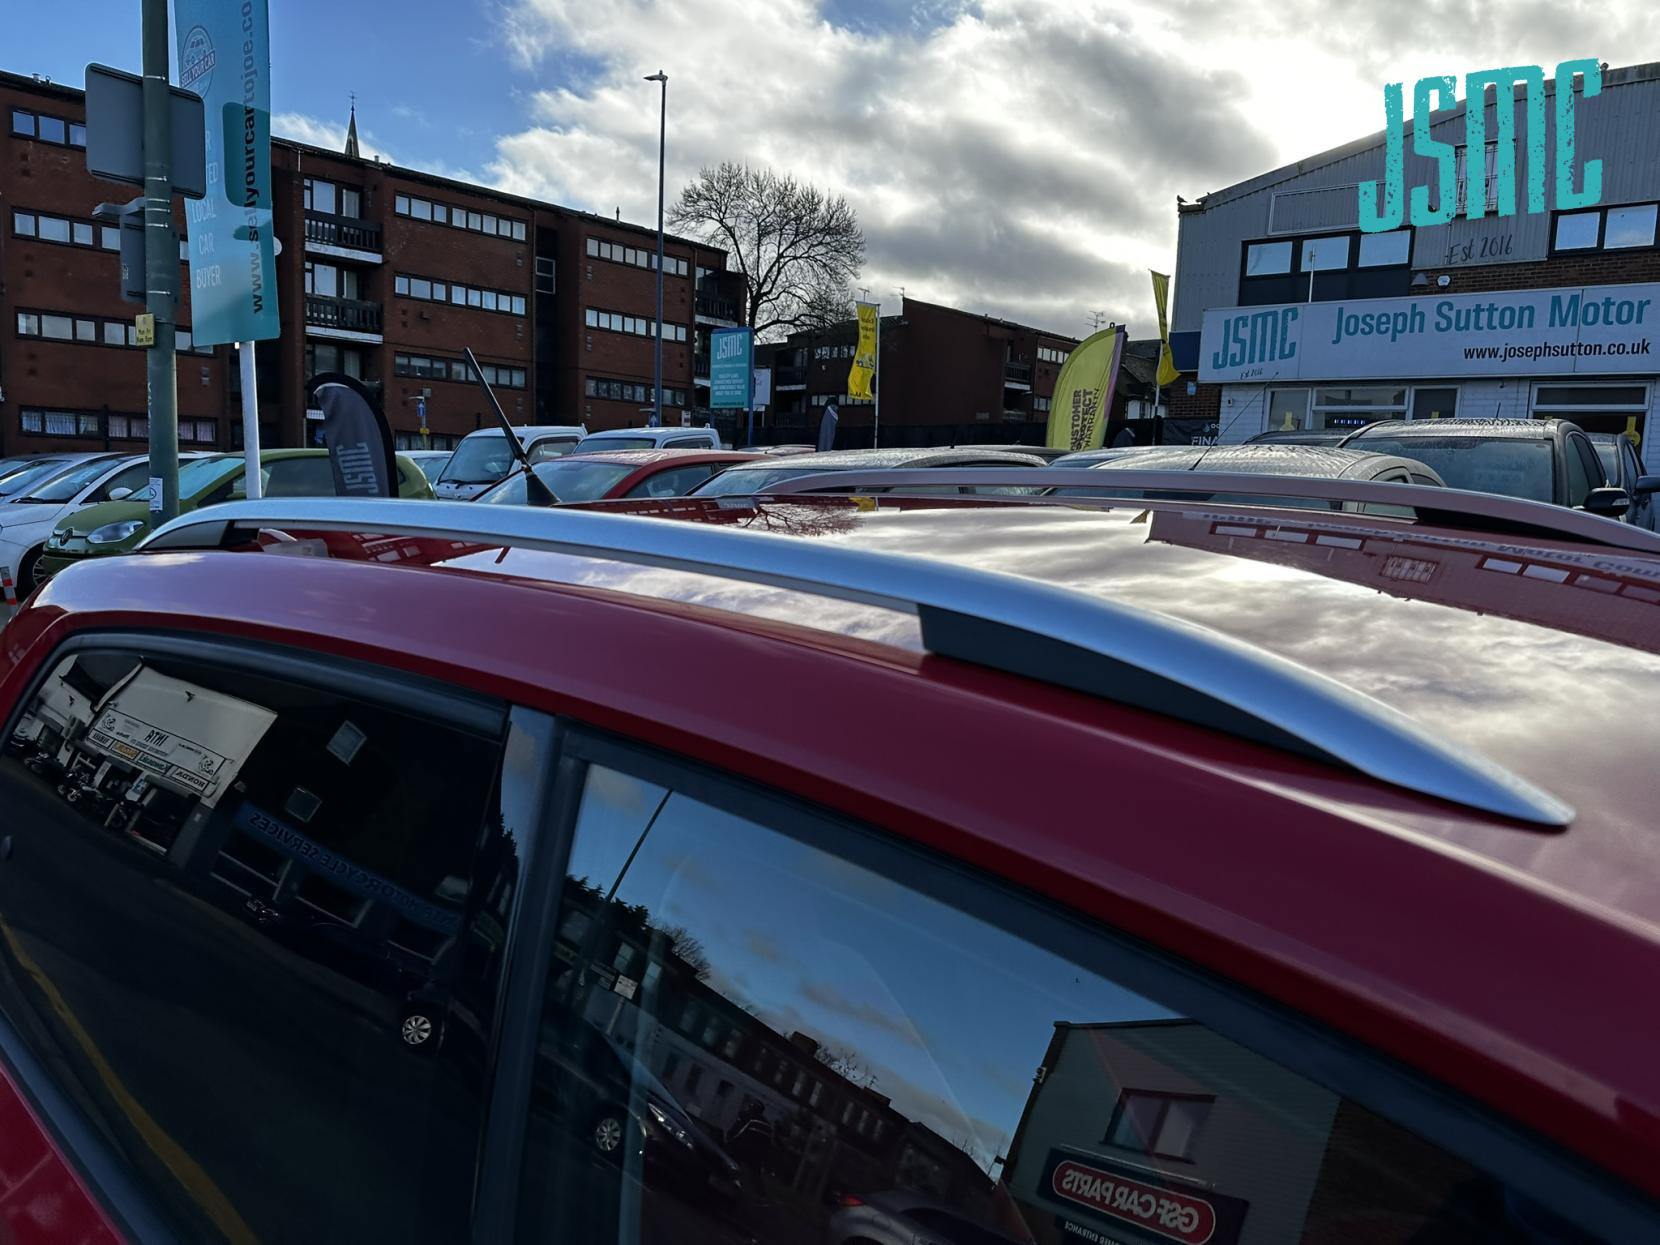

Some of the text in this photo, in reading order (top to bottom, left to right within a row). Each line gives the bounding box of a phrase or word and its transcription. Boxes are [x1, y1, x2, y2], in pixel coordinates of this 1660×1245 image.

[181, 53, 215, 87] SELL YOUR CAR
[191, 202, 217, 223] LOCAL
[198, 232, 215, 255] CAR
[195, 265, 222, 289] BUYER
[1332, 294, 1651, 345] Joseph Sutton Motor
[717, 334, 743, 360] JSMC
[1212, 306, 1299, 370] JSMC
[1464, 338, 1651, 362] www.josephsutton.co.uk
[337, 441, 379, 494] JSMC
